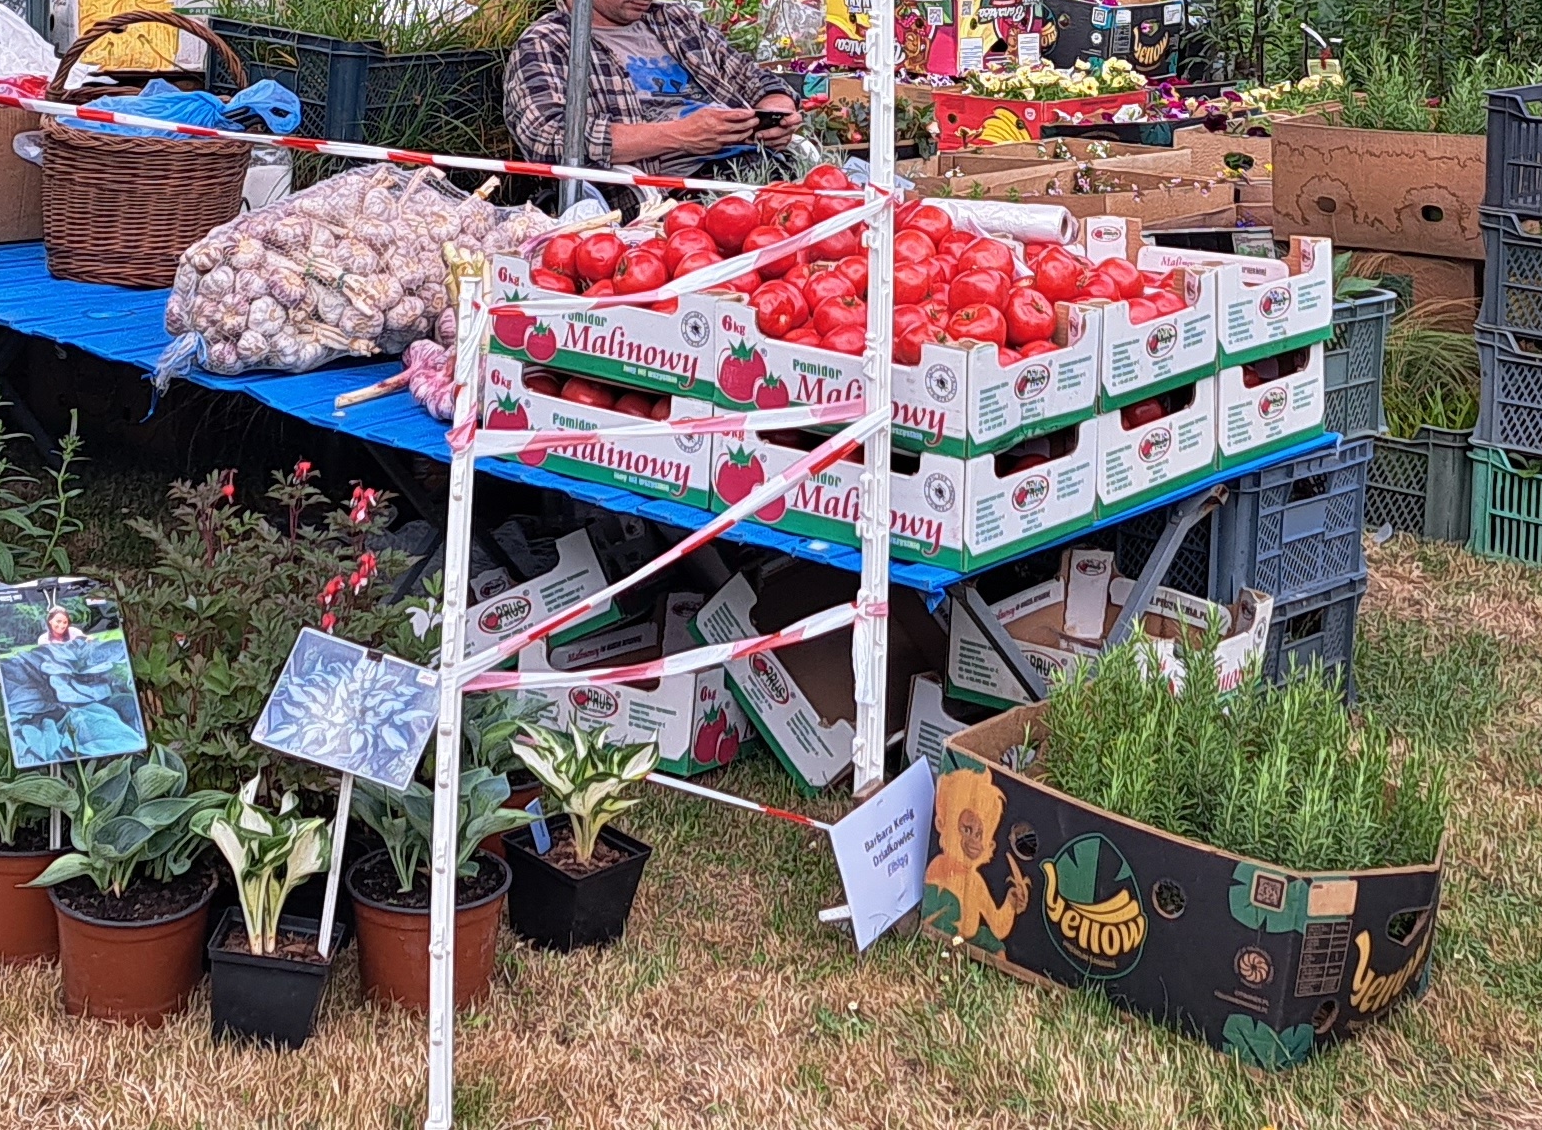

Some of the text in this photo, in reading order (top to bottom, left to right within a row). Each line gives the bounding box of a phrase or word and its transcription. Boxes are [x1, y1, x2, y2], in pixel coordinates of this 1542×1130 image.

[721, 314, 746, 336] 6kg
[562, 321, 699, 390] Malinowy
[792, 358, 843, 380] Pomidor
[496, 599, 529, 623] PRUS
[765, 665, 786, 701] PRUS
[586, 688, 613, 711] PRUS
[864, 825, 893, 853] Barbara
[1042, 861, 1145, 957] yellow
